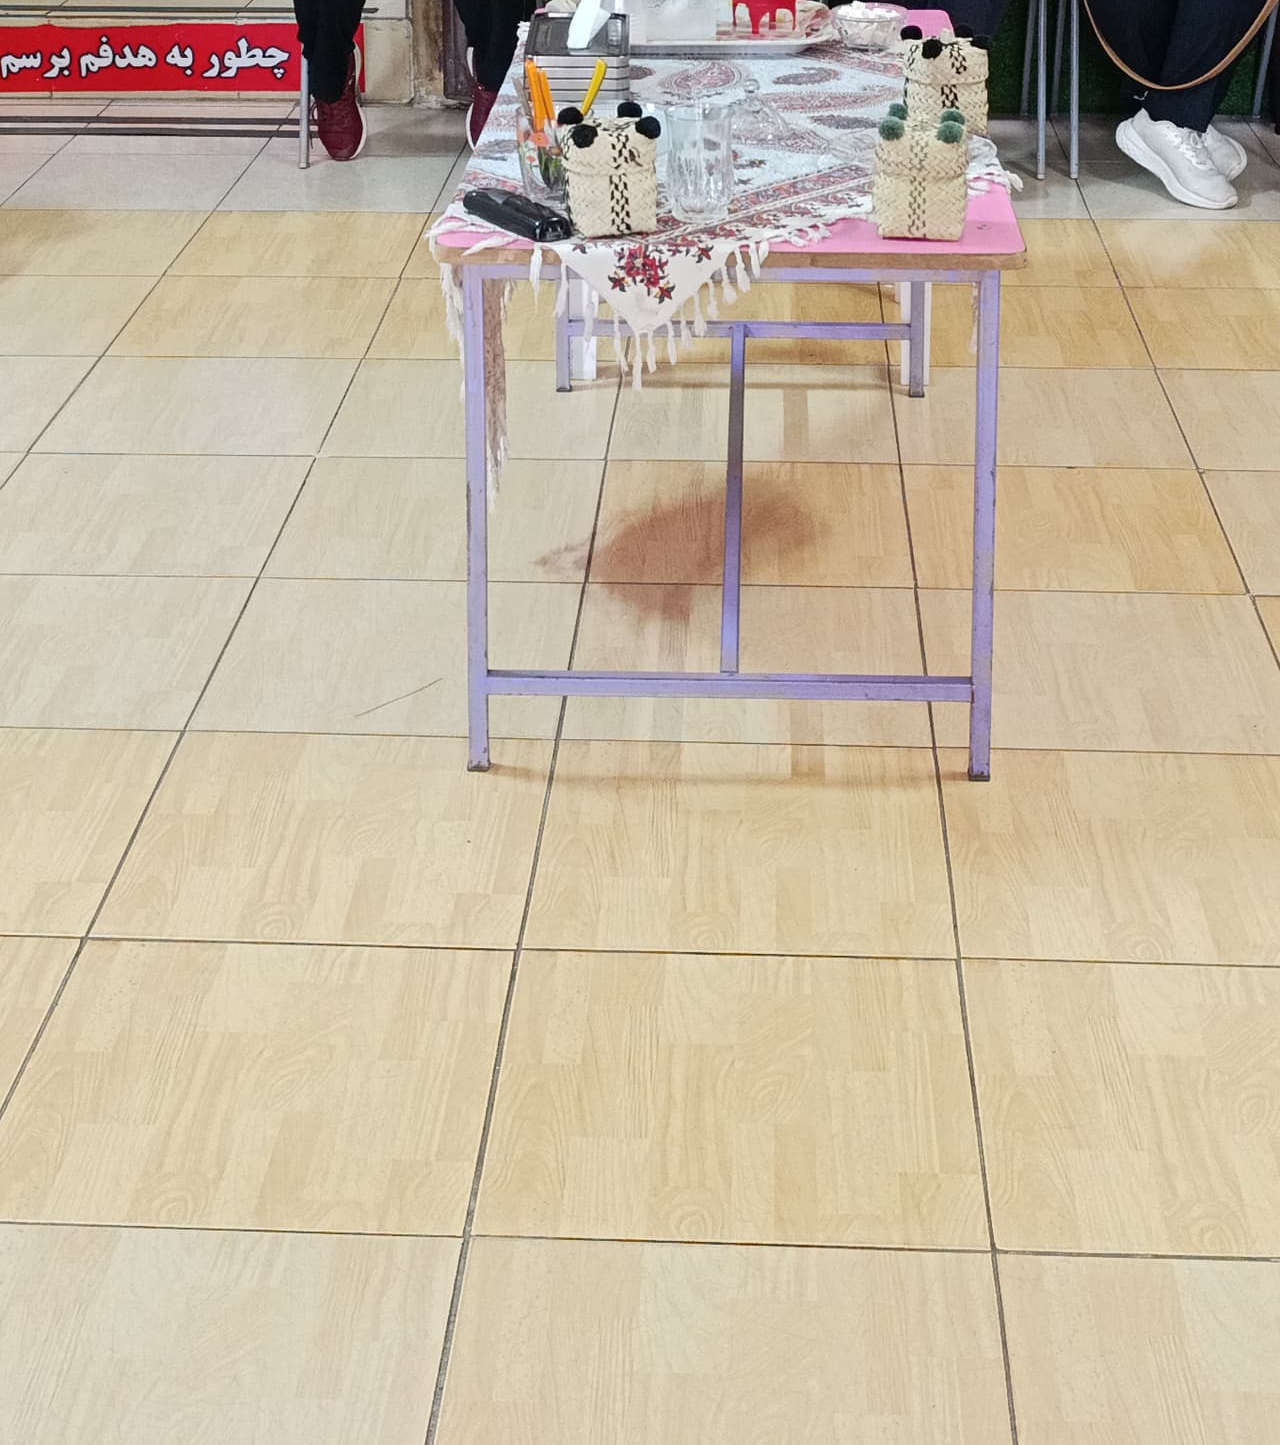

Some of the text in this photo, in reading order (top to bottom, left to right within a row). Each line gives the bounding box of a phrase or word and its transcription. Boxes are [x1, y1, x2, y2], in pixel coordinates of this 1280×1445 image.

[80, 35, 157, 78] هدفم
[165, 44, 194, 76] به
[202, 38, 290, 79] چطور
